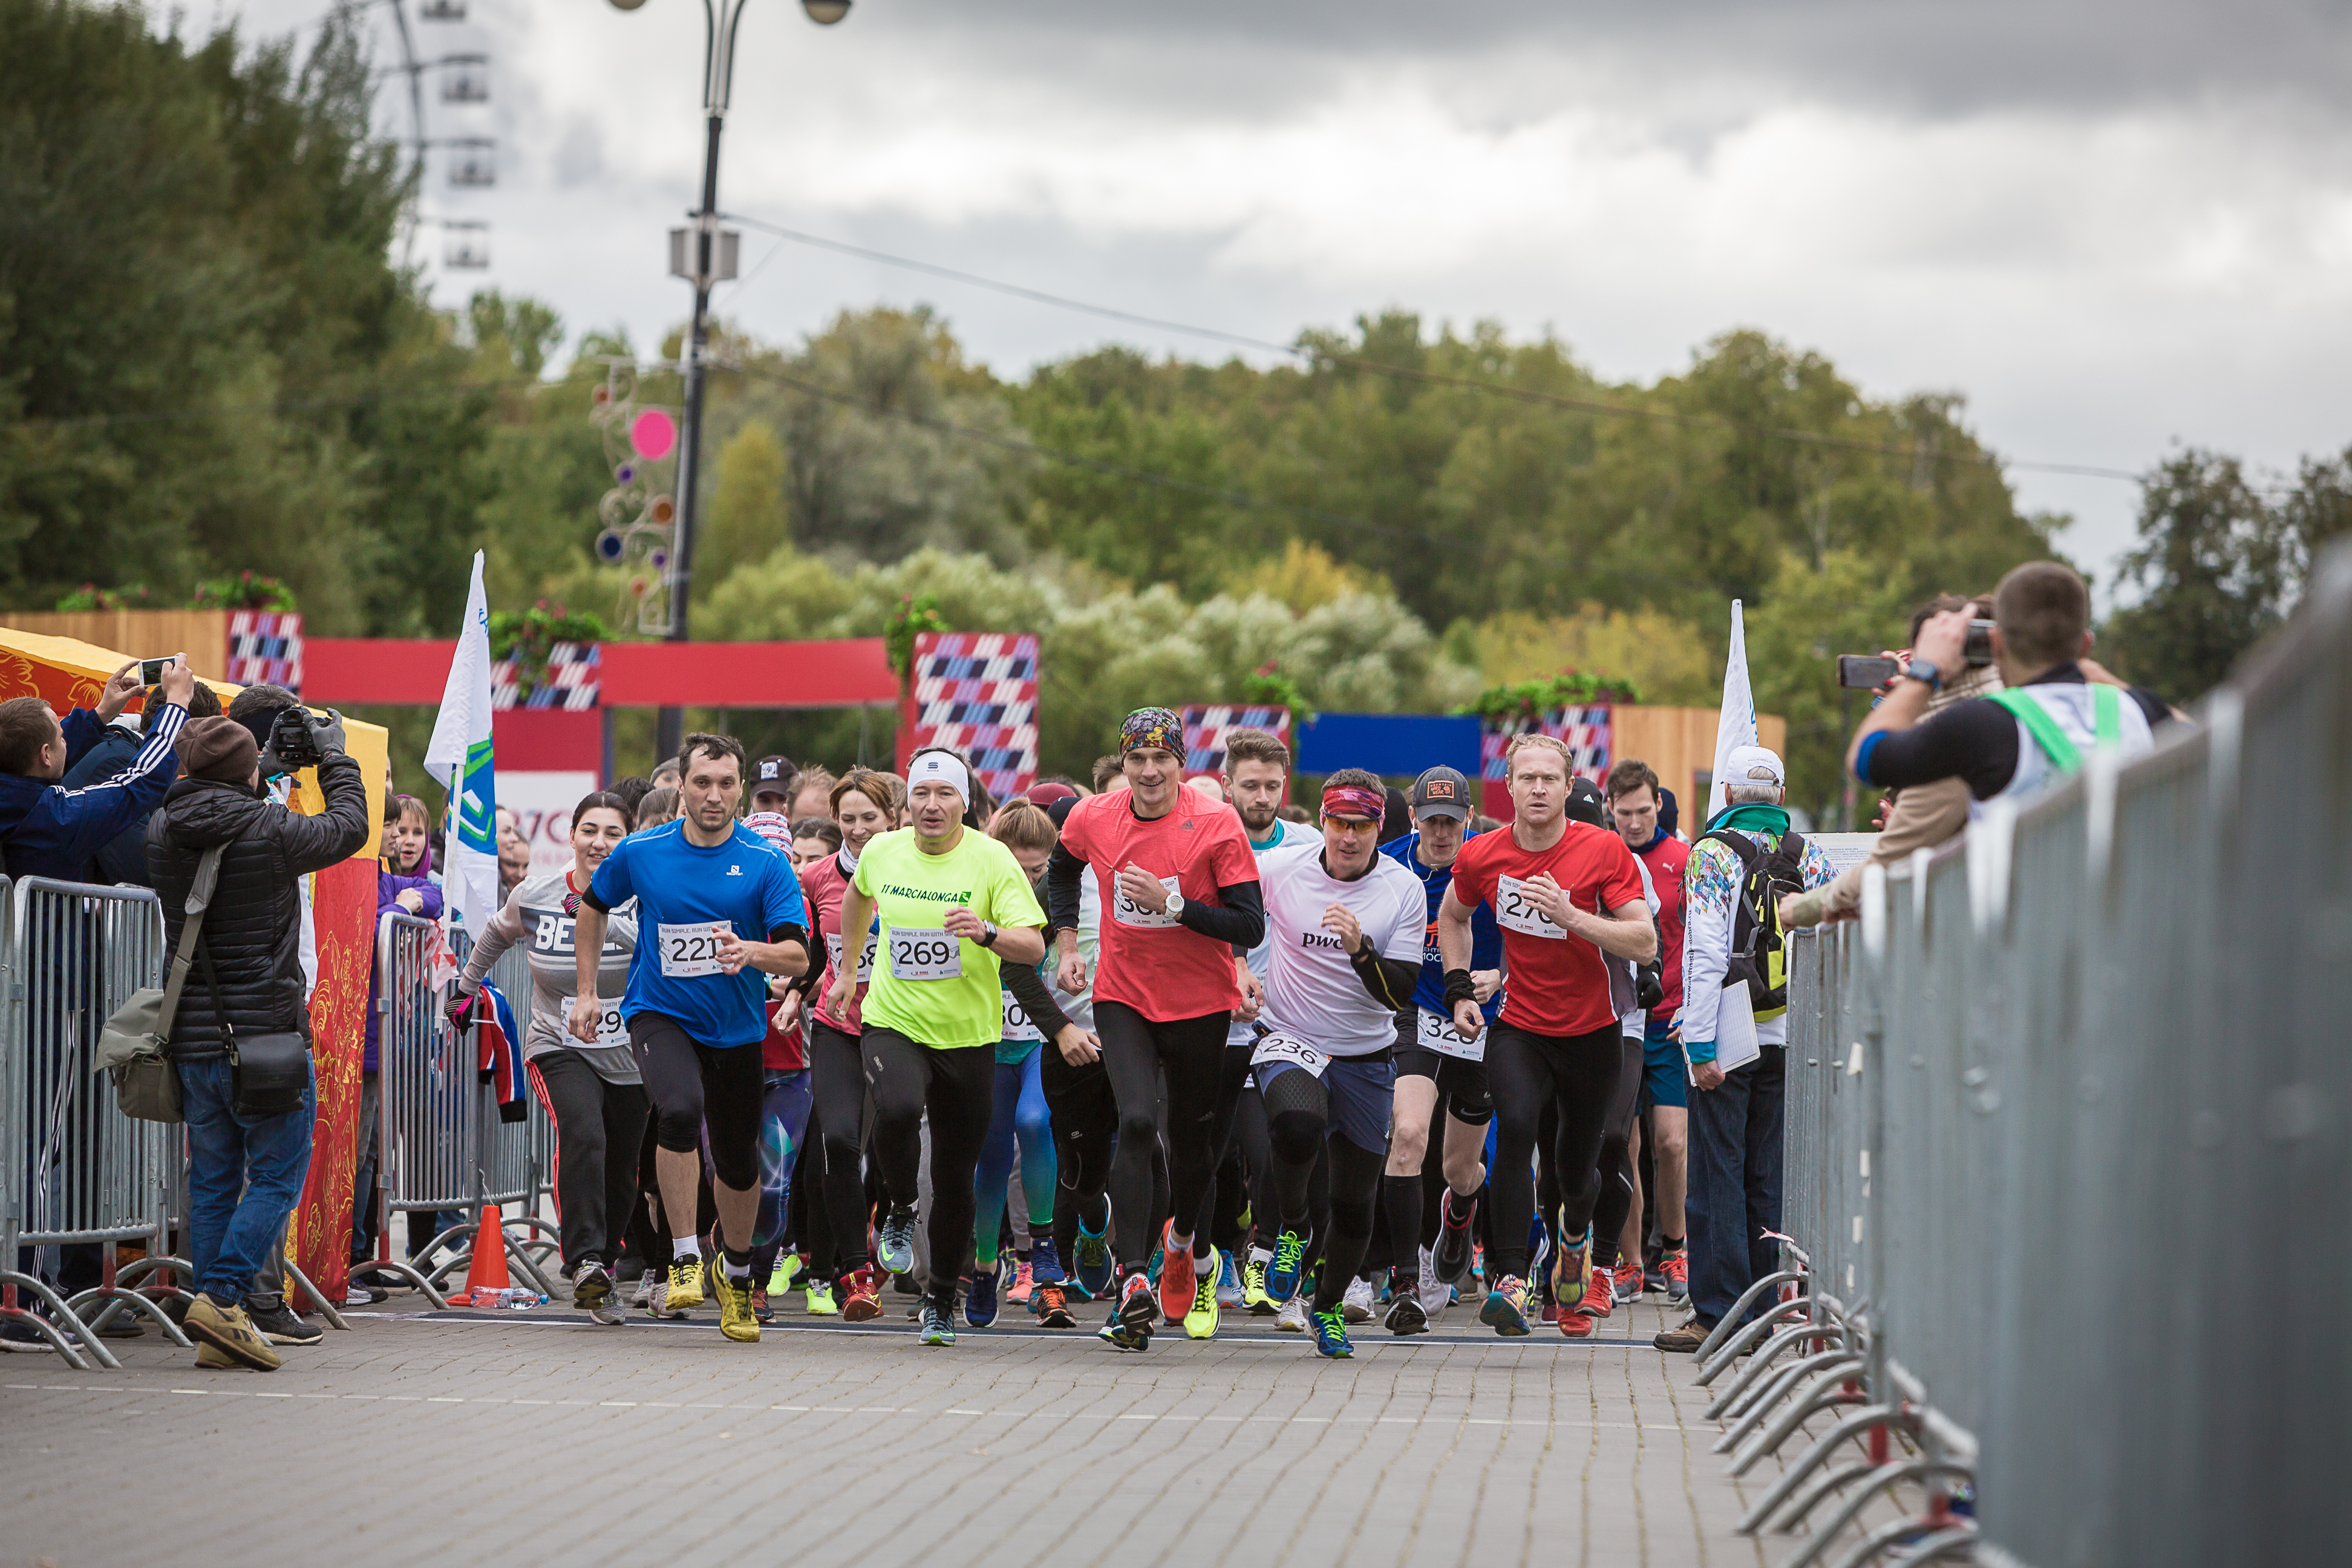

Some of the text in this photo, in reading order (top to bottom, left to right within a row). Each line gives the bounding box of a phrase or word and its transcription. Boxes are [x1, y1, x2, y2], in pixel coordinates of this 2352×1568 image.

[890, 885, 958, 903] MARCIALONGA
[671, 937, 717, 962] 221
[897, 941, 950, 965] 269
[1301, 932, 1343, 950] pwc
[1263, 1039, 1318, 1064] 236
